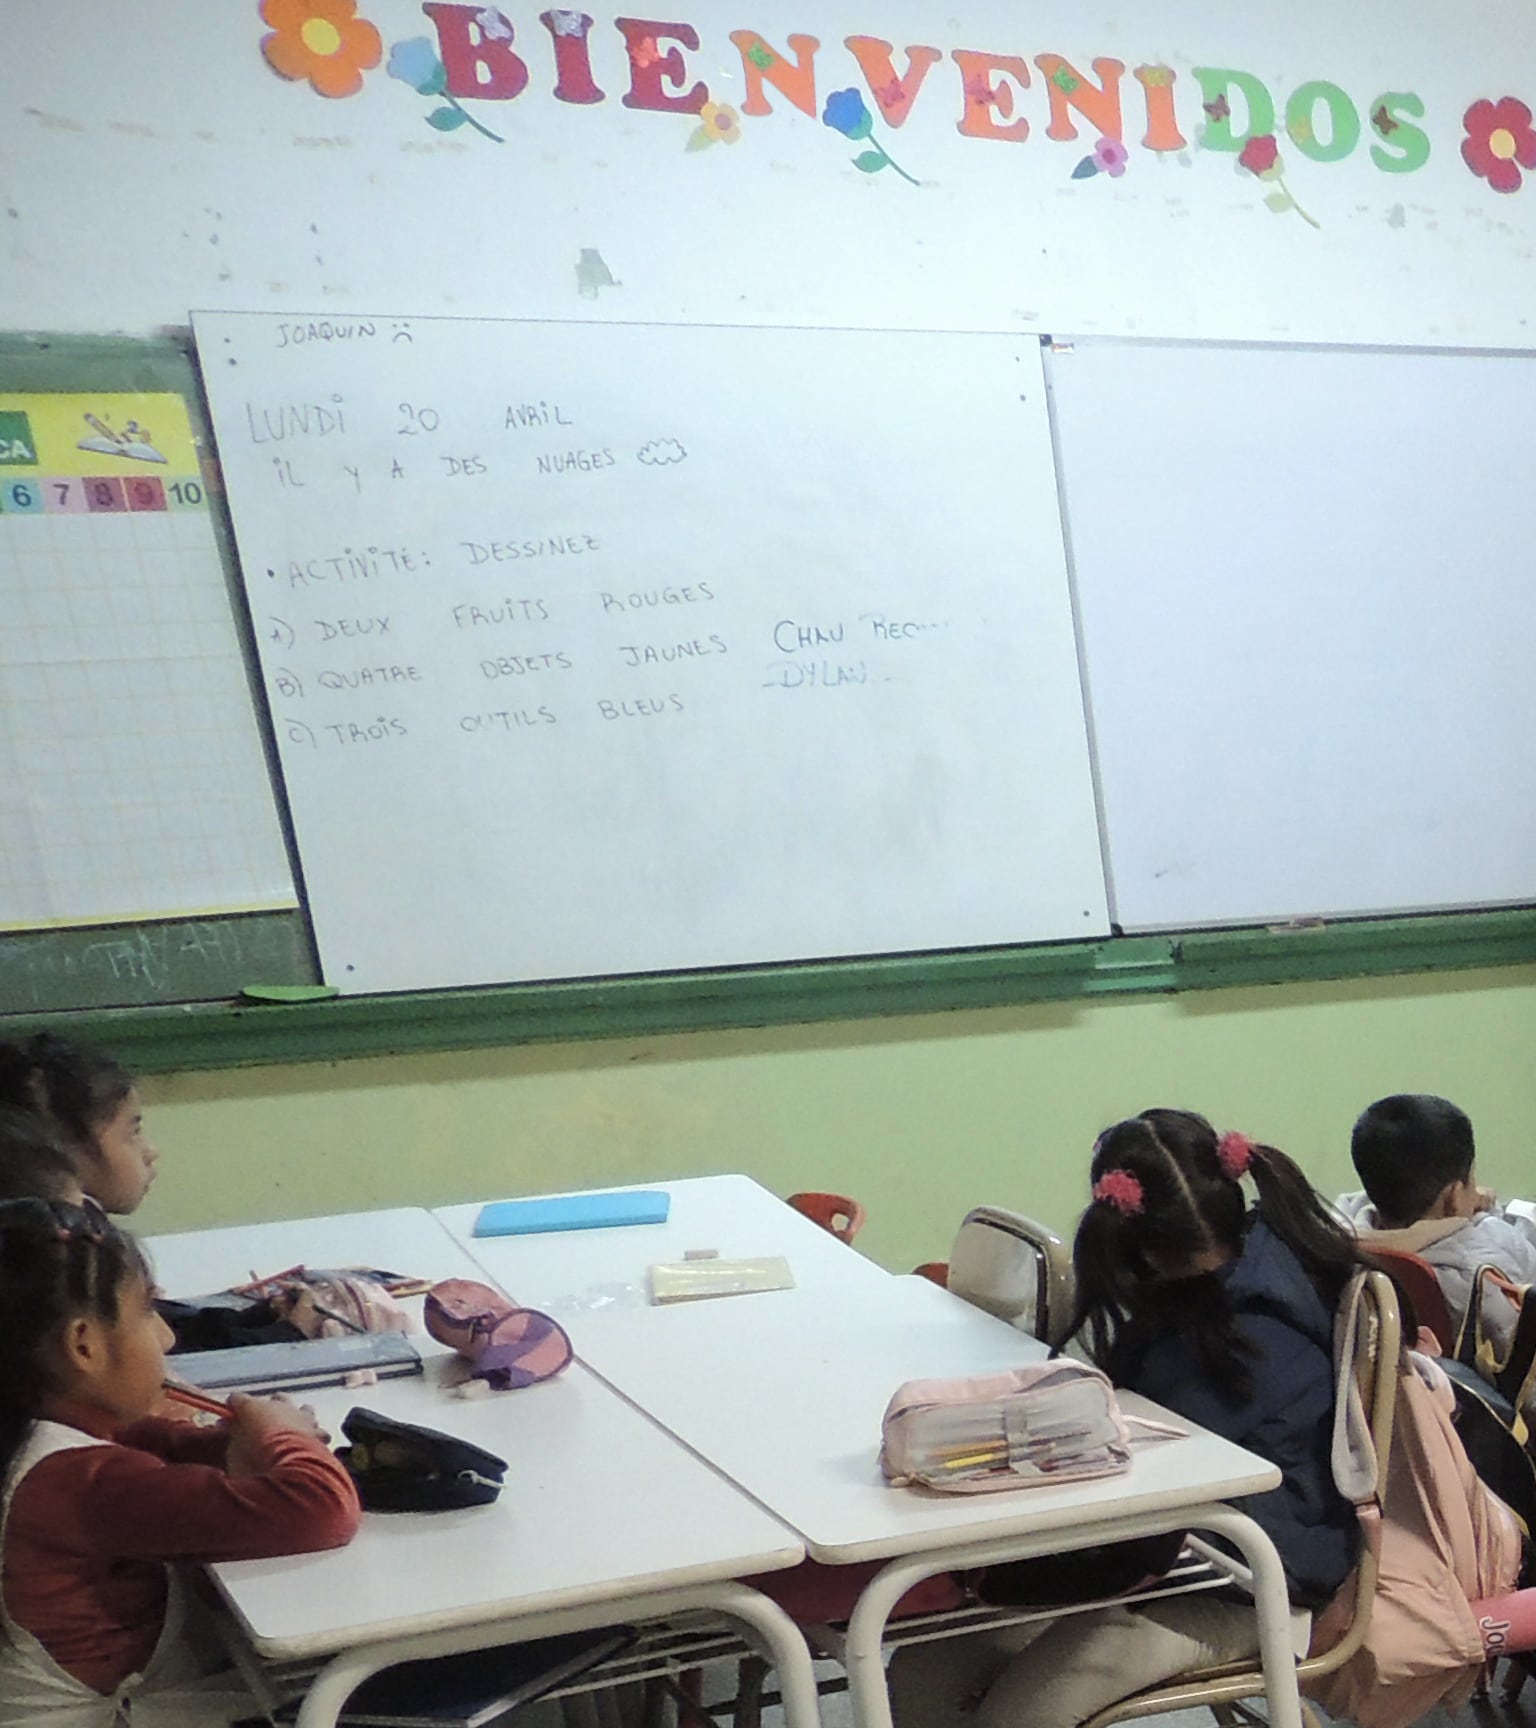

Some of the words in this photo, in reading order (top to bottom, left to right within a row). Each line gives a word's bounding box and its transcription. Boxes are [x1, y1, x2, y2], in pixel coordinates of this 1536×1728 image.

[423, 1, 1432, 174] BIENVENIDOS
[276, 323, 376, 349] JOAQUIN
[397, 402, 440, 435] 20
[391, 458, 404, 479] A
[441, 455, 488, 477] DES
[537, 448, 616, 474] NUAGES
[12, 484, 32, 507] 6
[53, 484, 69, 506] 7
[94, 483, 114, 506] 8
[134, 482, 155, 505] 9
[169, 482, 201, 505] 10
[461, 535, 600, 565] DESSINEZ
[314, 616, 391, 641] DEUX
[599, 582, 715, 614] ROUGES
[773, 620, 844, 653] CHAU
[275, 666, 302, 698] B)
[318, 664, 422, 690] QUATRE
[480, 652, 573, 680] OBJETS
[619, 634, 728, 667] JAUNES
[285, 718, 317, 749] C)
[460, 706, 557, 733] OUTILS
[597, 694, 685, 722] BLEUS
